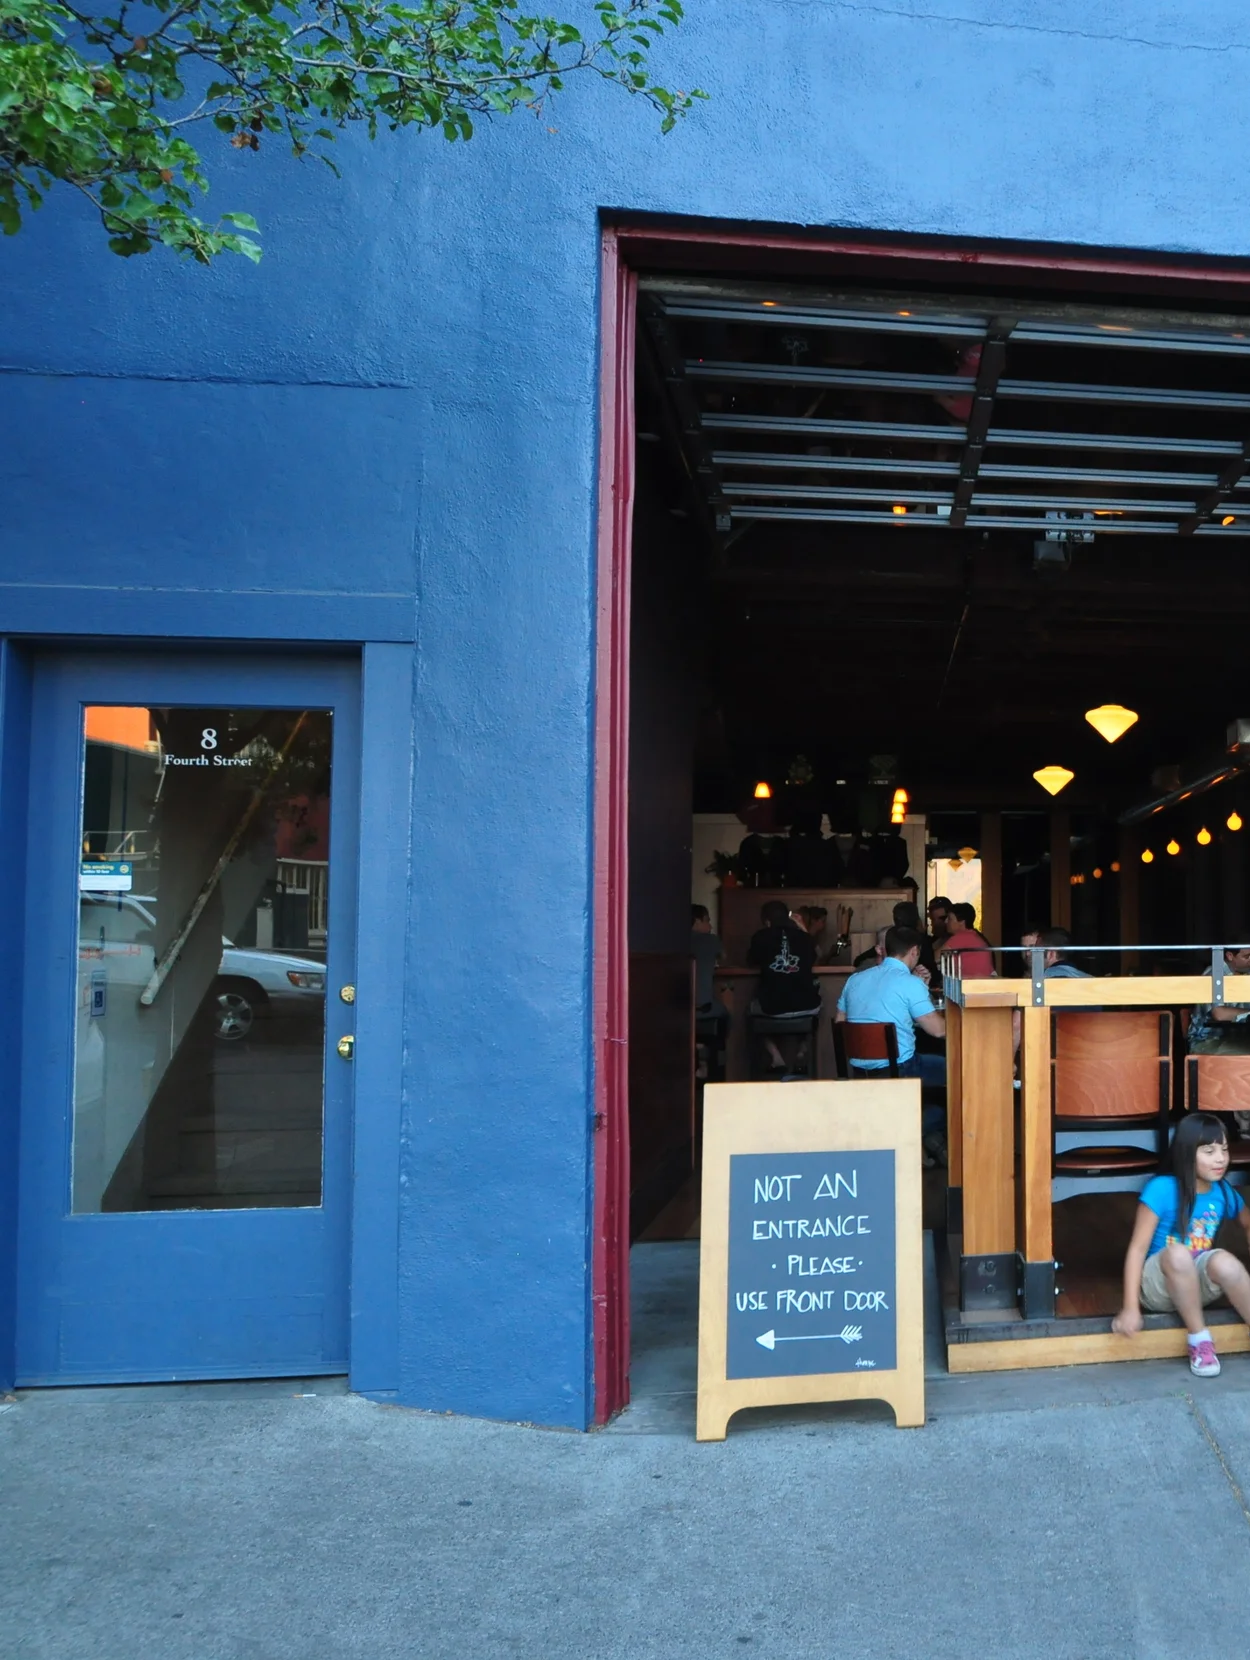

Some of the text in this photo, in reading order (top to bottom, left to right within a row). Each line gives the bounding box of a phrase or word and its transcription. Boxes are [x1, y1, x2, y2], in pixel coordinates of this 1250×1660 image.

[200, 728, 218, 750] 8
[164, 754, 253, 767] Fourth Street
[754, 1169, 858, 1204] NOT AN
[752, 1215, 872, 1241] ENTRANCE
[787, 1254, 857, 1276] PLEASE
[735, 1289, 890, 1314] USE FRONT DOOR
